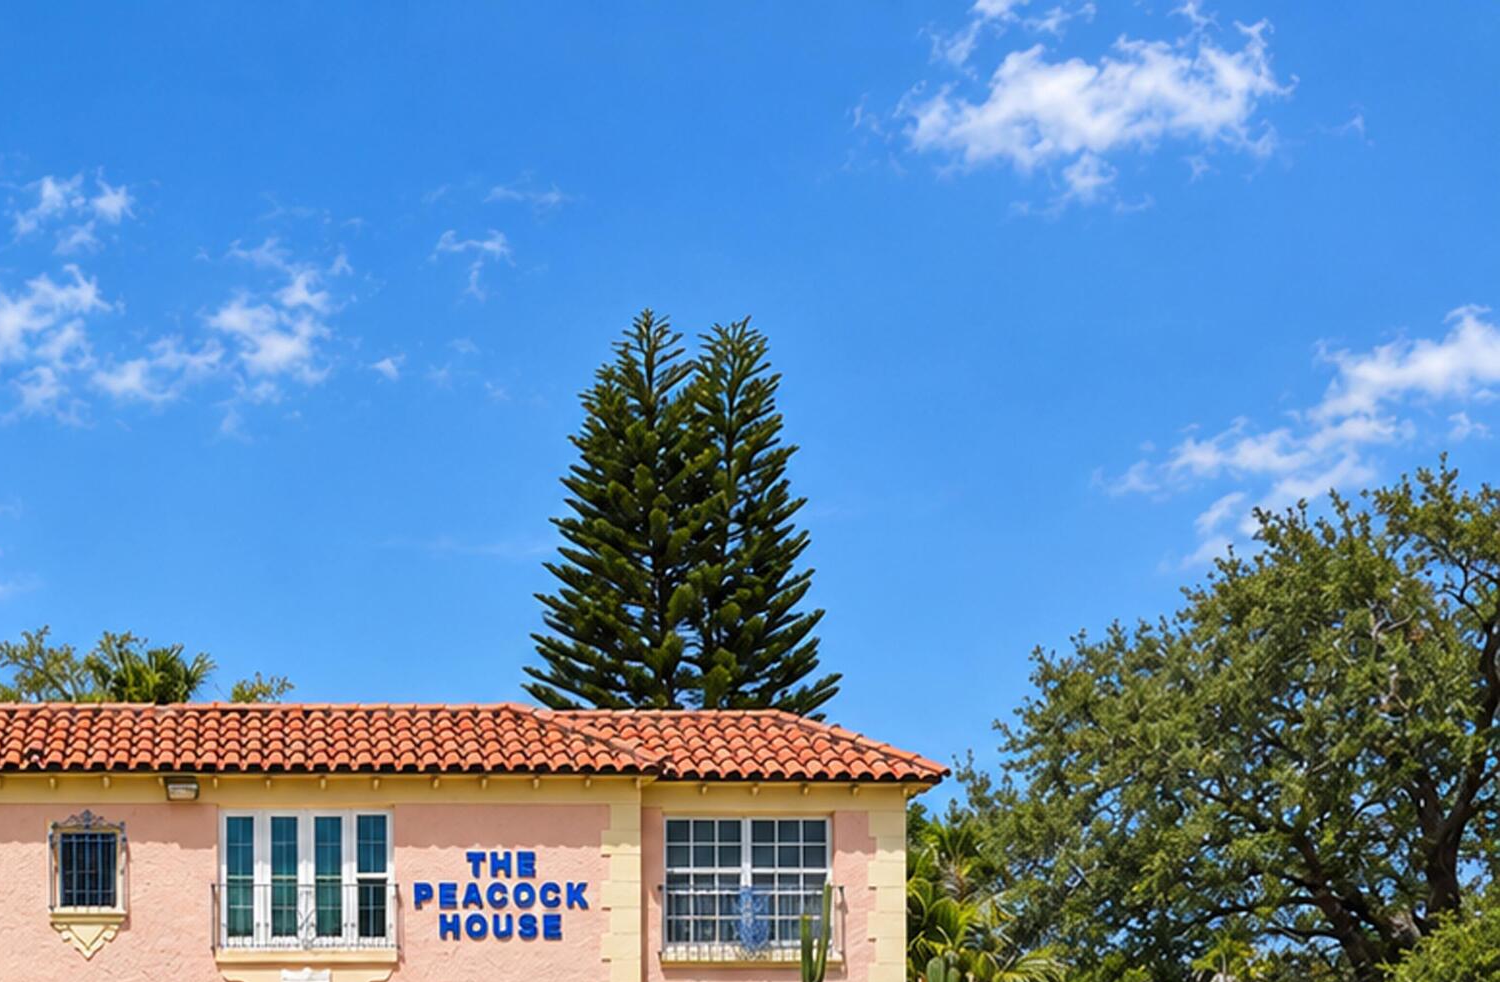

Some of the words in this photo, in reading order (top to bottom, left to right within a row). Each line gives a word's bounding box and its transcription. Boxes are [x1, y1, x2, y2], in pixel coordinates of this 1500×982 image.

[466, 851, 537, 879] THE
[413, 882, 590, 910] PEACOCK
[439, 913, 563, 941] HOUSE
